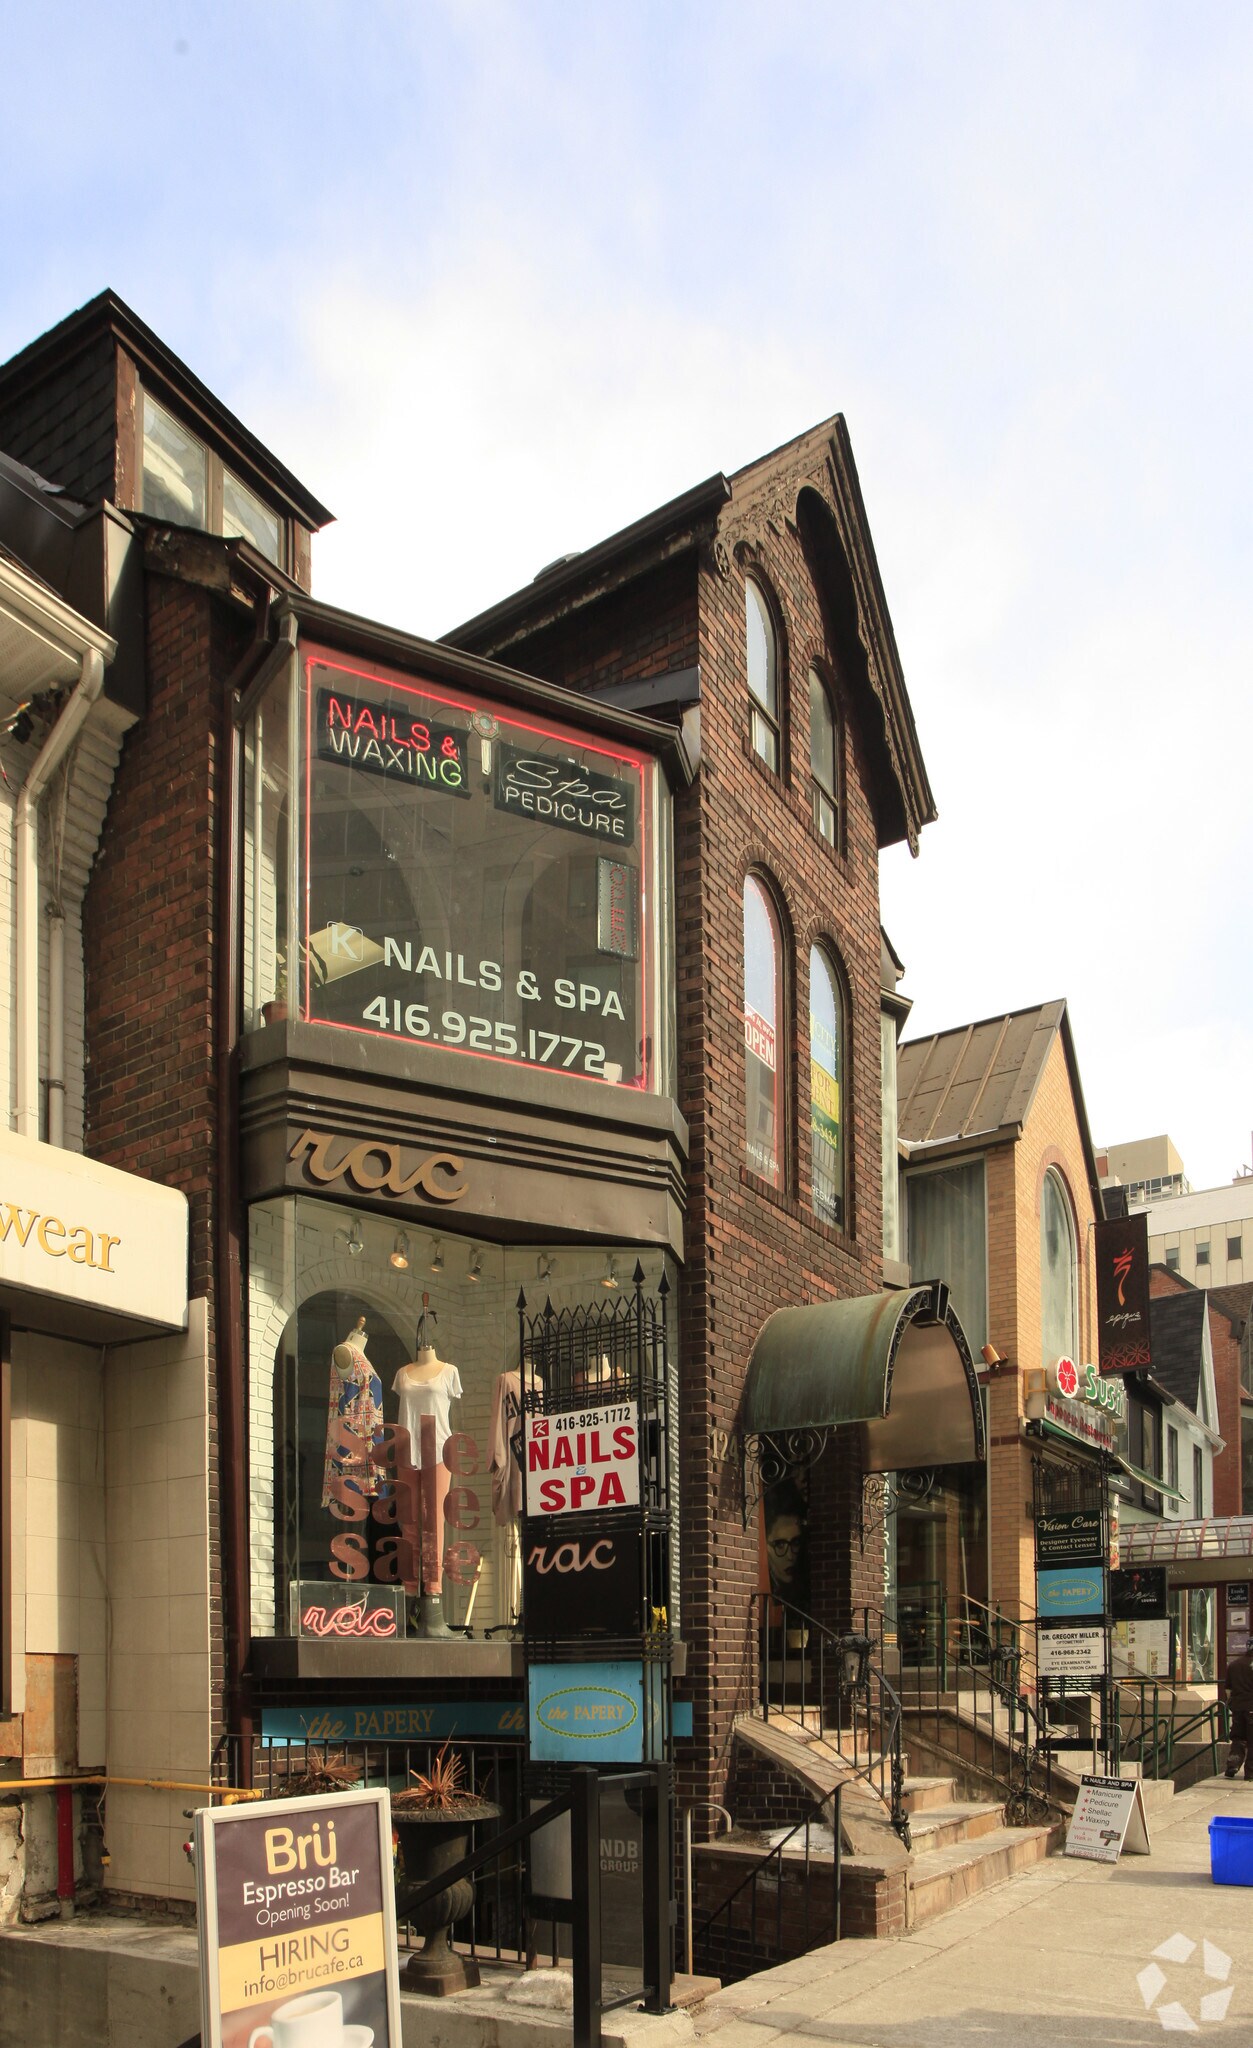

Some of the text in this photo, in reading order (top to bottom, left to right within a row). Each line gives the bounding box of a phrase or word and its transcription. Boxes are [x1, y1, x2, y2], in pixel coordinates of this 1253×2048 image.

[329, 698, 458, 761] NAILS &
[330, 728, 462, 787] WAXING
[506, 760, 626, 809] Spa
[505, 787, 625, 837] PEDICURE
[330, 923, 358, 959] K
[384, 937, 625, 1021] NAILS & SPA
[363, 996, 606, 1073] 416.925.1772
[745, 1020, 774, 1067] OPEN
[811, 1066, 831, 1090] FOR
[812, 1086, 835, 1115] ENT
[290, 1128, 470, 1200] rac
[0, 1204, 121, 1273] wear
[534, 1407, 631, 1437] K 416-925-1772
[329, 1414, 480, 1477] sale
[529, 1426, 635, 1472] NAILS
[710, 1429, 739, 1465] 124
[576, 1466, 587, 1476] &
[329, 1471, 480, 1531] sale
[540, 1472, 626, 1512] SPA
[1038, 1516, 1099, 1532] Vision Care
[1040, 1536, 1098, 1547] Designer Eyewear
[329, 1527, 481, 1586] sale
[527, 1539, 617, 1574] rac
[1062, 1587, 1092, 1597] PAPERY
[303, 1606, 396, 1637] rac
[1079, 1631, 1100, 1639] MILLER
[308, 1709, 435, 1739] the PAPERY
[498, 1708, 525, 1732] th
[548, 1704, 625, 1720] the PAPERY
[1089, 1798, 1119, 1808] Pedicure
[1092, 1789, 1122, 1799] Manicure
[1085, 1816, 1110, 1826] Waxing
[1087, 1807, 1112, 1817] Shellac
[264, 1820, 337, 1875] Brü
[600, 1838, 638, 1858] NDB
[600, 1859, 639, 1872] GROUP
[243, 1867, 359, 1907] Espresso Bar
[256, 1893, 350, 1928] Opening Soon!
[259, 1928, 350, 1972] HIRING
[244, 1954, 363, 1998] info@brucafe.ca
